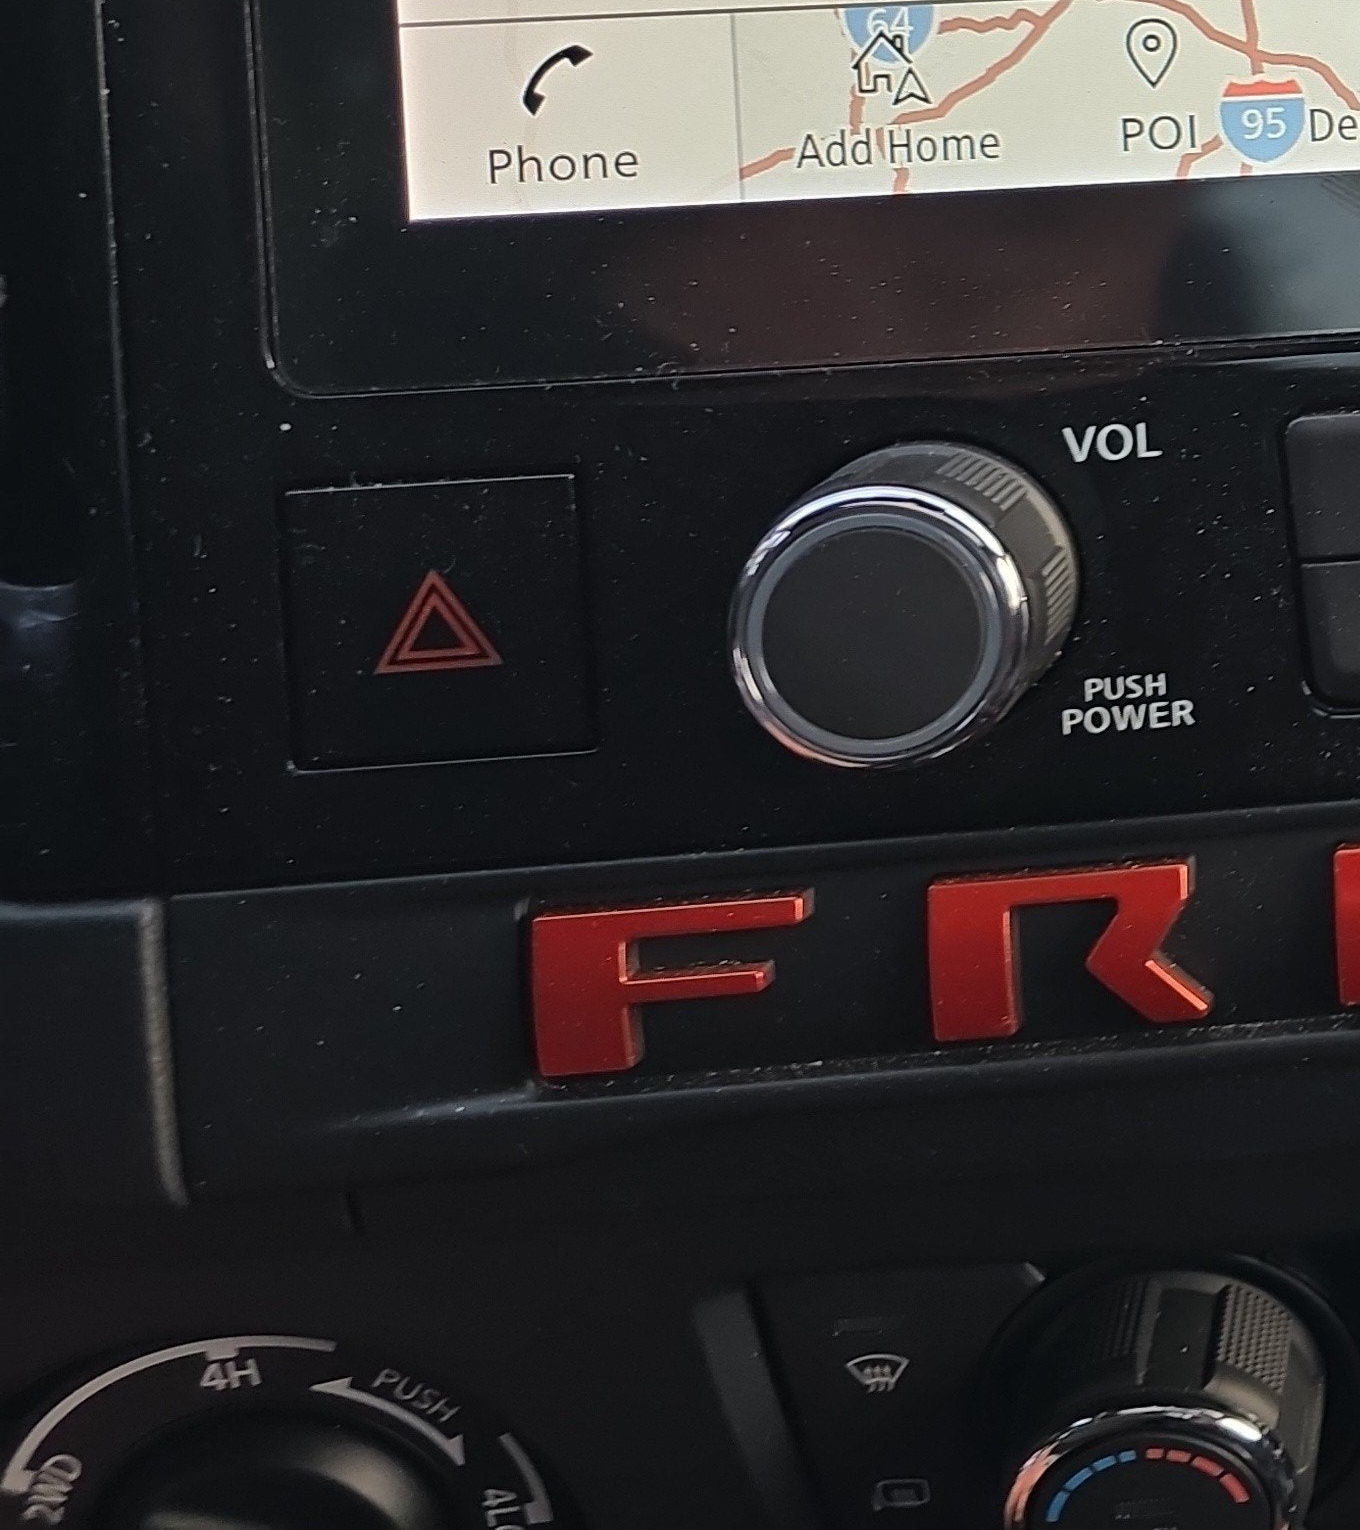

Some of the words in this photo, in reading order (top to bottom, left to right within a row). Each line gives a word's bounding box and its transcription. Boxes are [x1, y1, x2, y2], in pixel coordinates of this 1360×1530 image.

[1122, 116, 1198, 153] POI
[1241, 107, 1288, 141] 95
[488, 145, 640, 185] Phone
[796, 130, 873, 170] Add
[887, 126, 1001, 164] Home
[1062, 421, 1163, 464] VOL
[1082, 671, 1168, 704] PUSH
[1060, 698, 1195, 736] POWER
[200, 1357, 263, 1392] 4H
[371, 1367, 460, 1424] PUSH
[481, 1488, 526, 1530] 4L
